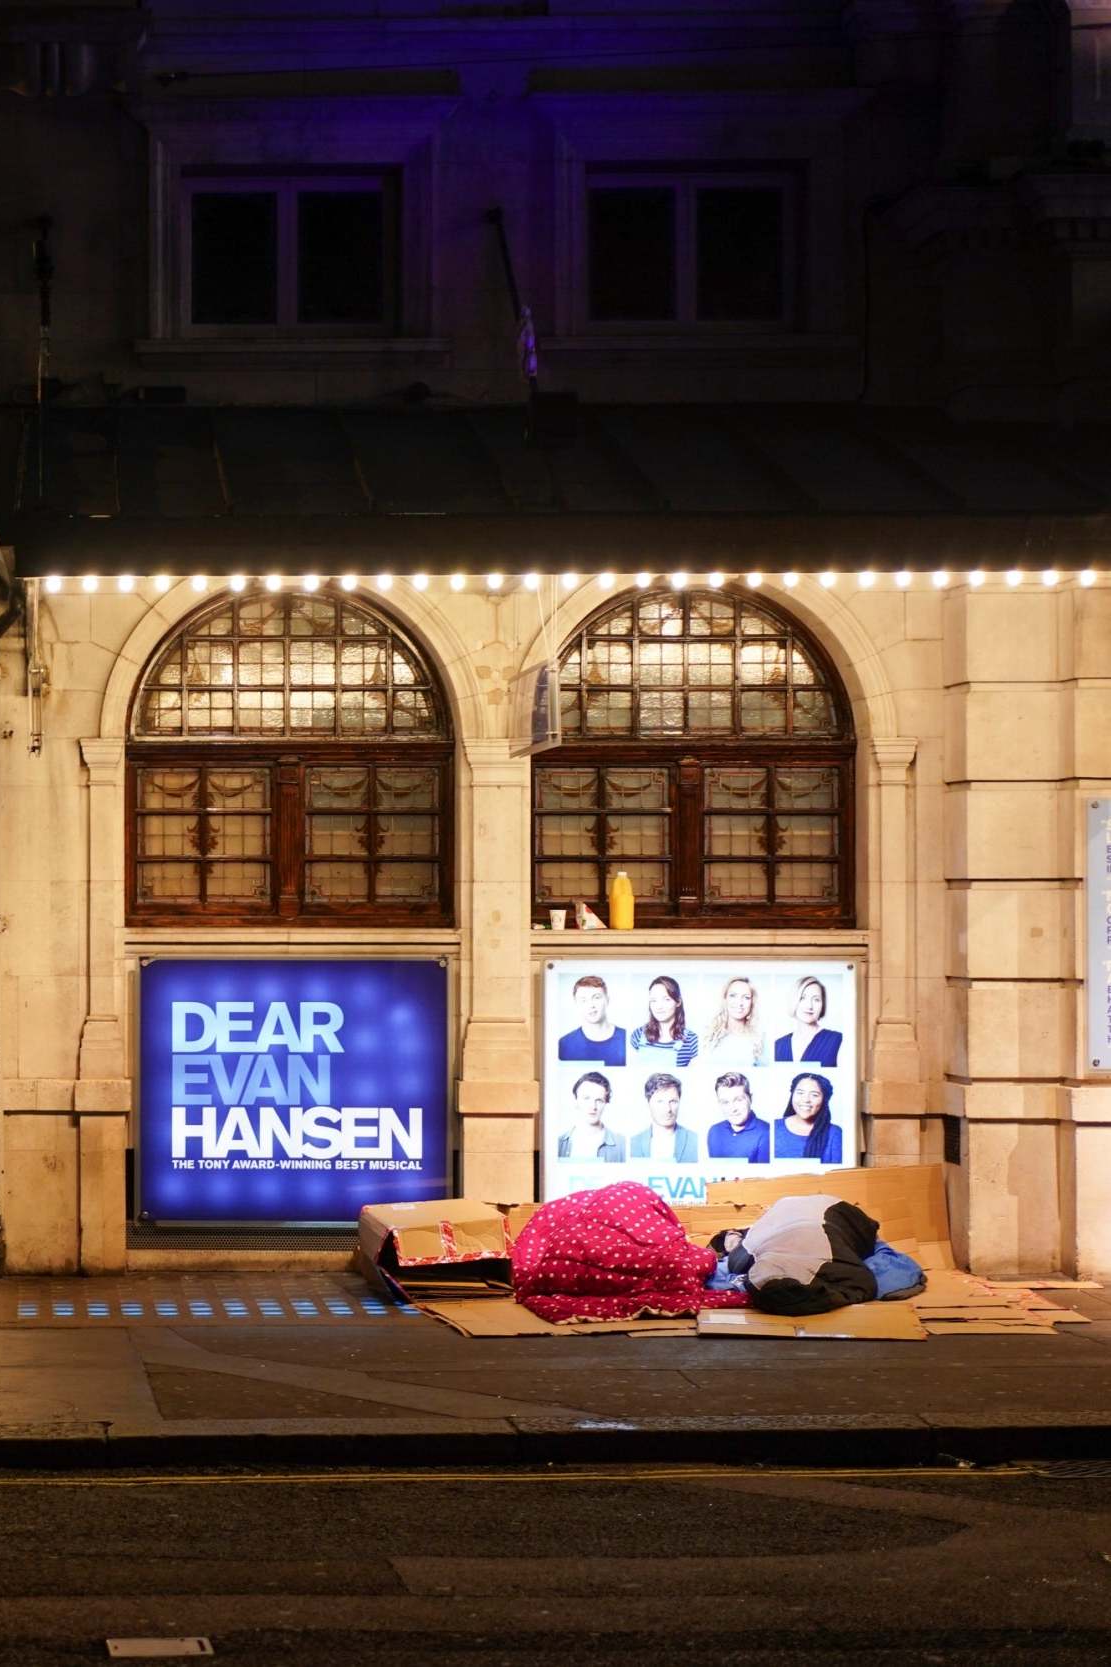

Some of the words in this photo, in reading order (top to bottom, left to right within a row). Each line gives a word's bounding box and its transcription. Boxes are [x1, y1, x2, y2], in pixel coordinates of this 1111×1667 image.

[172, 1001, 345, 1053] DEAR
[172, 1055, 331, 1105] EVAN
[172, 1106, 423, 1159] HANSEN
[172, 1160, 194, 1170] THE
[198, 1160, 230, 1170] TONY
[232, 1160, 332, 1170] AWARD-WINNING
[335, 1160, 366, 1170] BEST
[369, 1160, 423, 1171] MUSICAL
